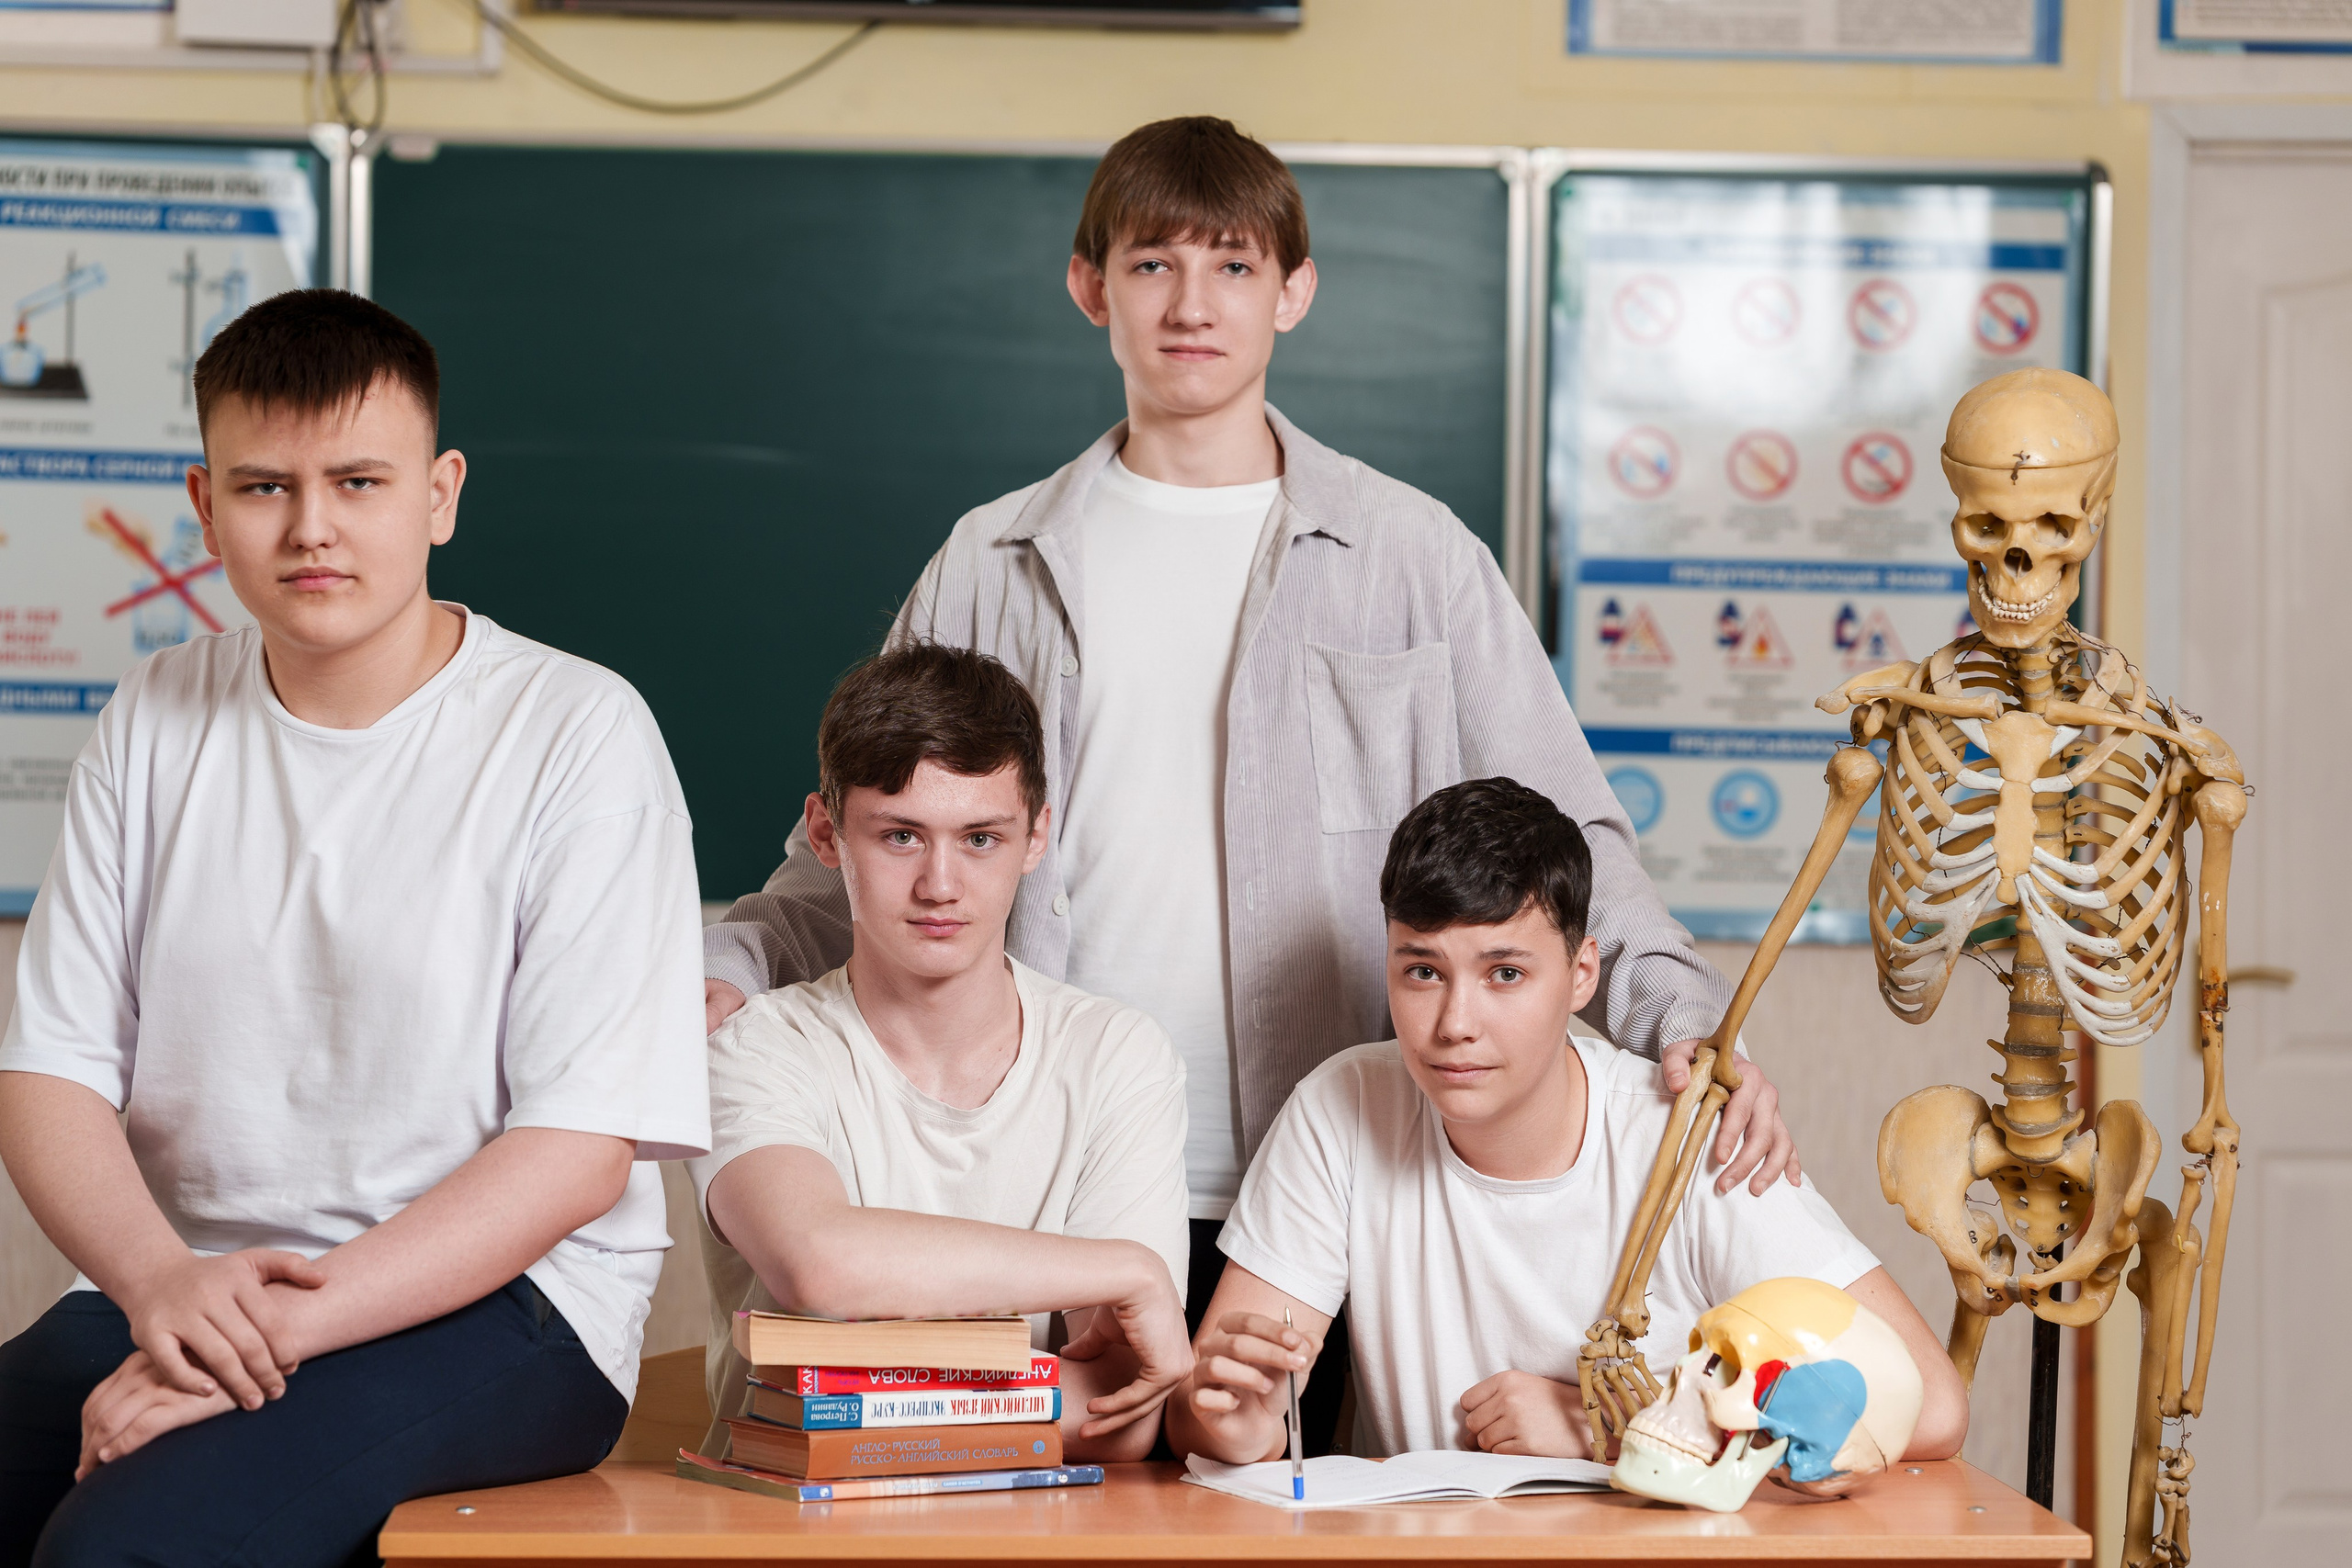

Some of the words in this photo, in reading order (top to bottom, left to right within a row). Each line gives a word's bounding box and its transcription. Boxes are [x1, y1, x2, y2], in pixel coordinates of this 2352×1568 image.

[867, 1369, 931, 1384] СЛОВА
[871, 1400, 945, 1419] ЭКСПРЕСС-КУРС
[950, 1398, 978, 1416] ЯЗЫК
[980, 1396, 1046, 1417] АНГЛИЙСКИЙ
[972, 1447, 1019, 1460] СЛОВАРЬ
